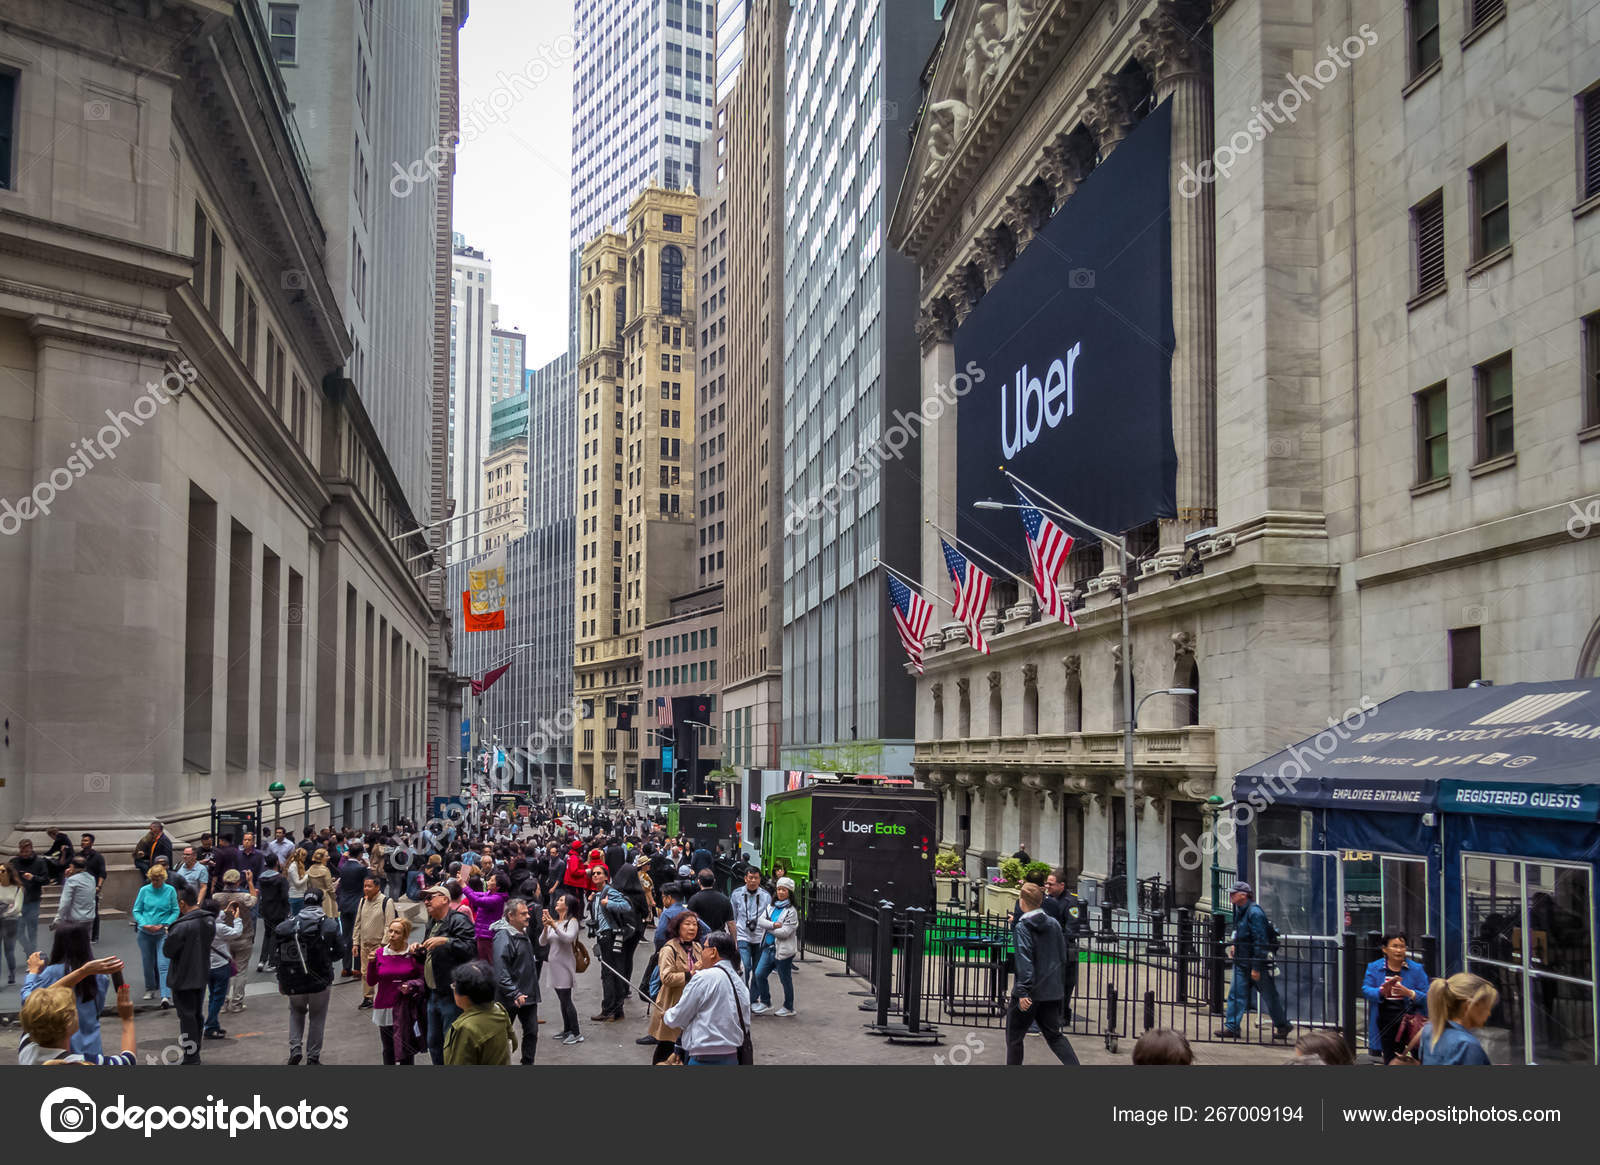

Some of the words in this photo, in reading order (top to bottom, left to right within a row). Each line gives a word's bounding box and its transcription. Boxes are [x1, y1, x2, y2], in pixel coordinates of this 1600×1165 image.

[1001, 341, 1080, 460] Uber
[1390, 727, 1448, 741] YORK
[1436, 728, 1516, 741] STOCK
[1332, 788, 1374, 801] EMPLOYEE
[1373, 790, 1421, 802] ENTRANCE
[1456, 789, 1527, 806] REGISTERED
[1530, 791, 1581, 809] GUESTS
[842, 820, 873, 833] Uber
[875, 822, 906, 835] Eats
